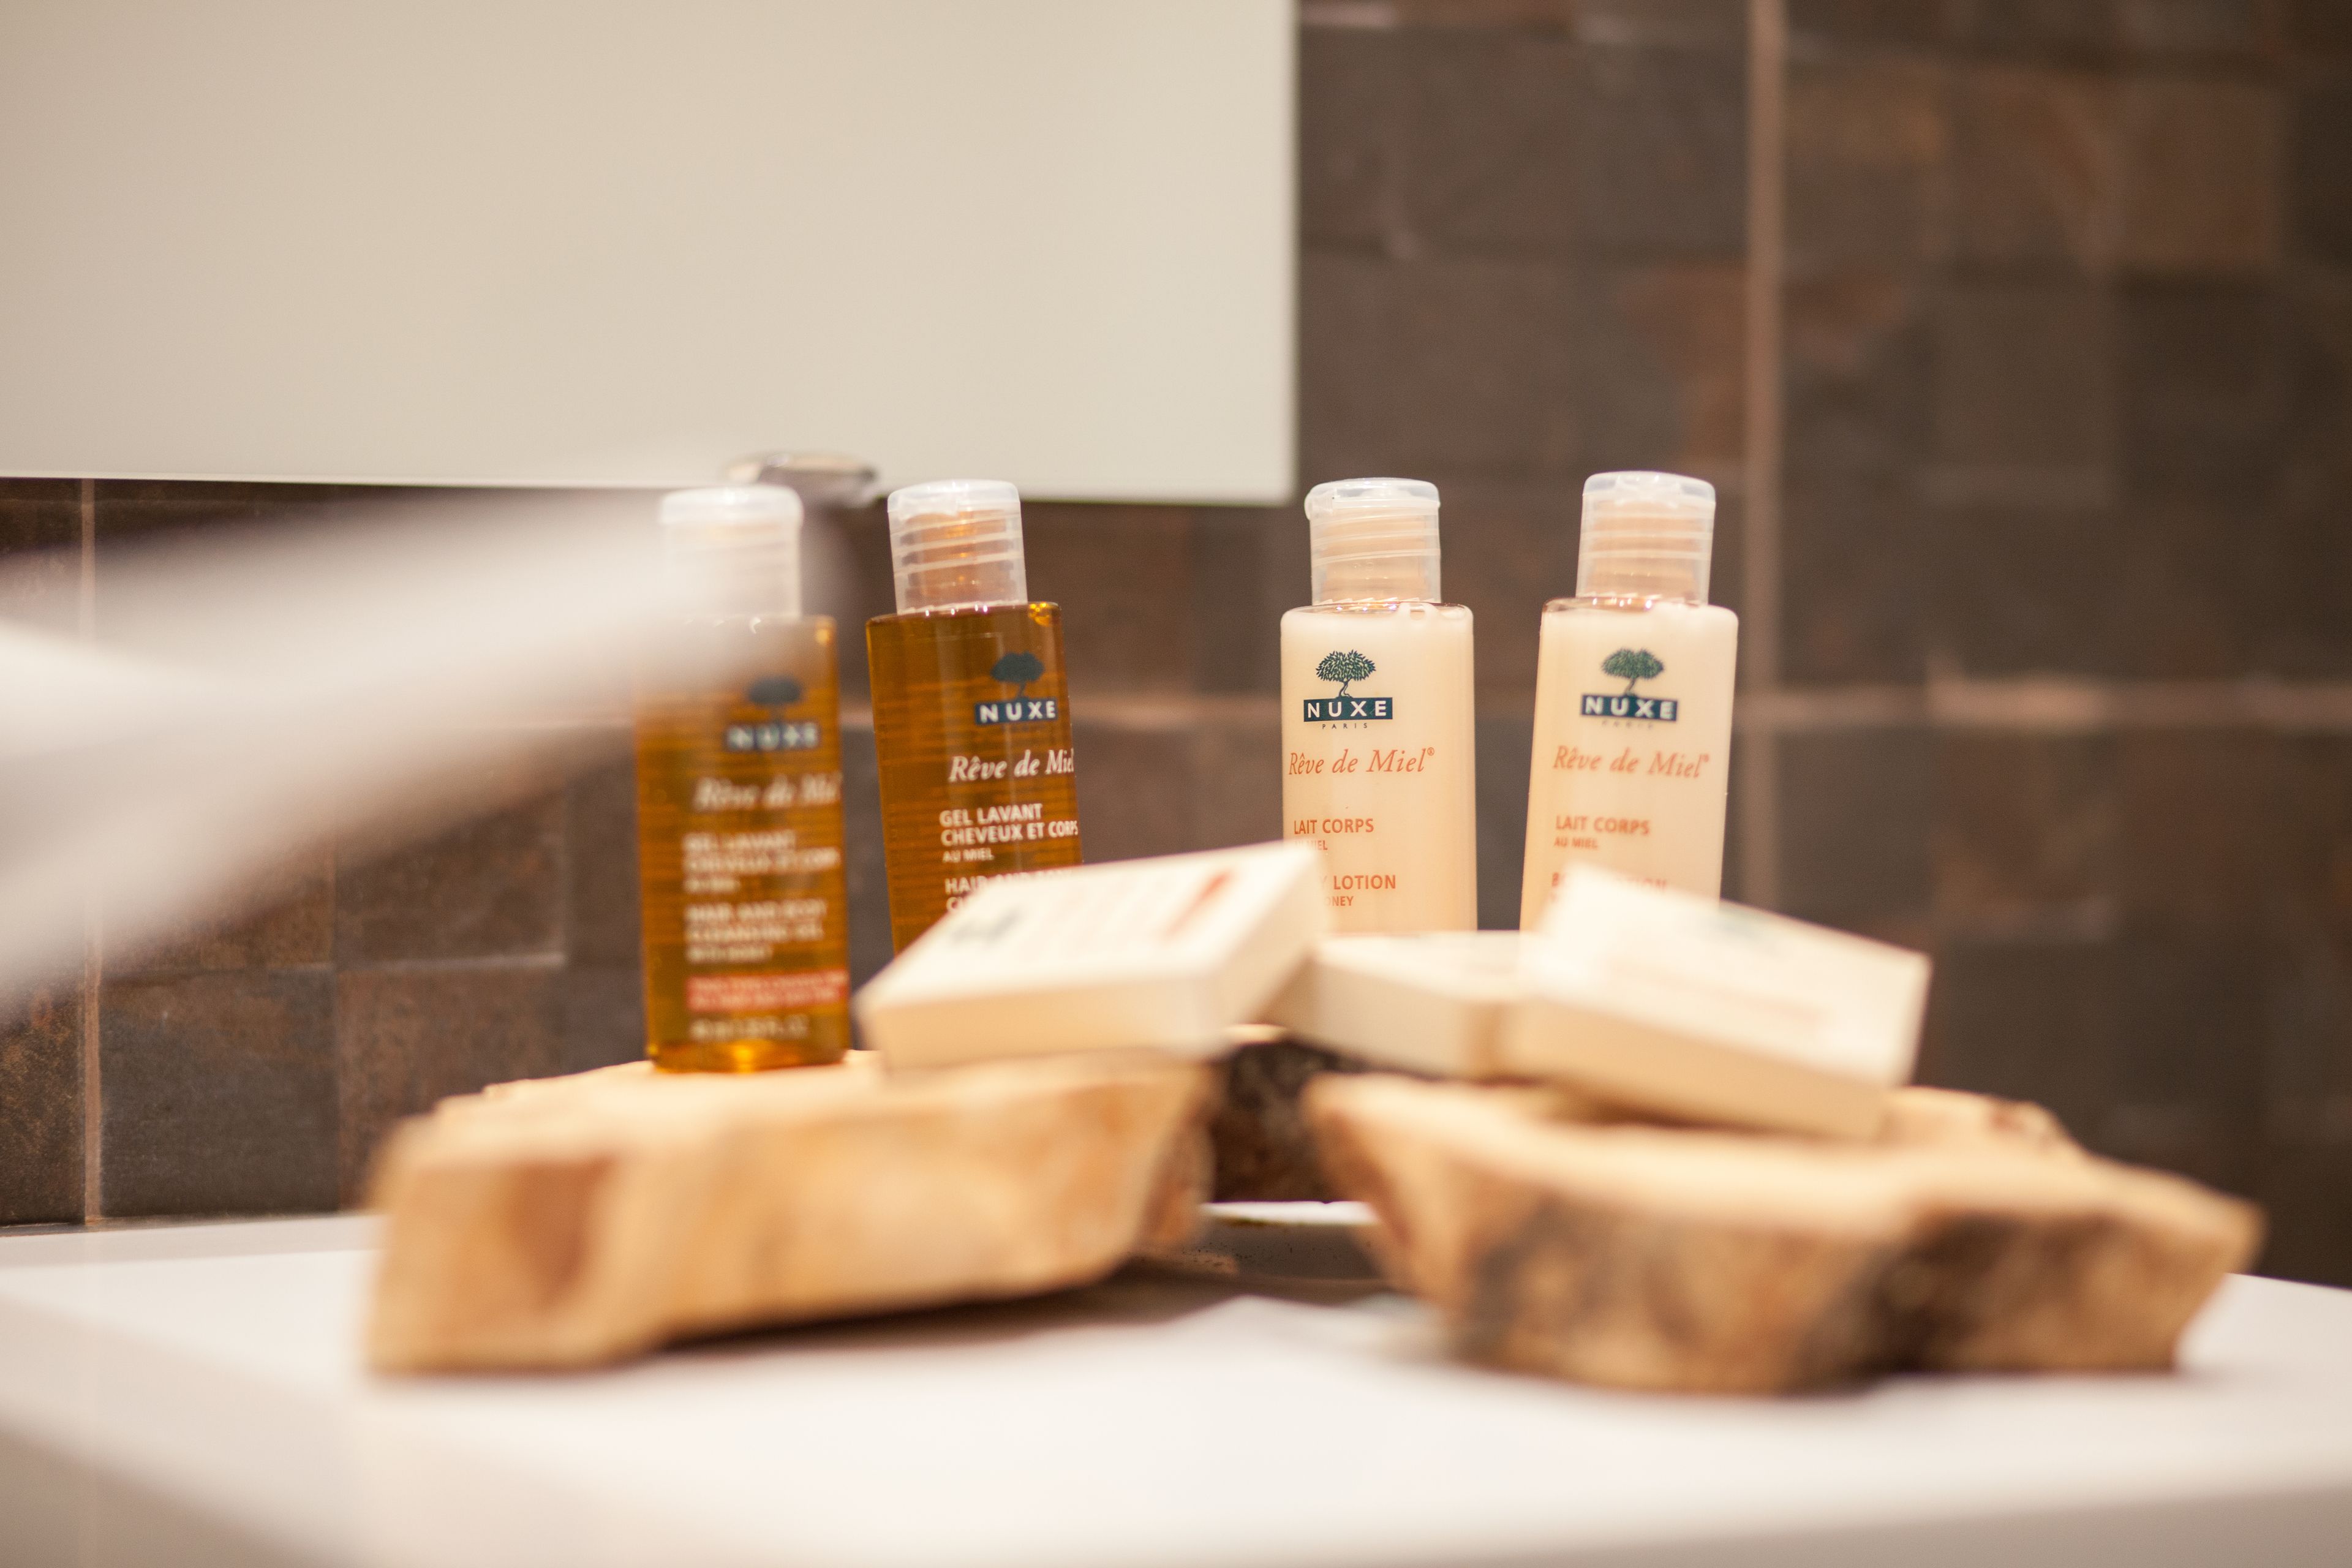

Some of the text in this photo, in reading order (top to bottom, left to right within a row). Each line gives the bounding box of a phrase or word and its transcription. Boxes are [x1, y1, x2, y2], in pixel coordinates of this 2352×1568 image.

[979, 700, 1057, 723] NUXE
[1308, 700, 1387, 718] NUXE
[1585, 696, 1675, 719] NUXE
[948, 755, 1008, 782] Rêve
[1014, 749, 1040, 777] de
[1289, 752, 1324, 775] Rêve
[1332, 748, 1358, 773] de
[1553, 745, 1602, 771] Rêve
[1609, 746, 1639, 773] de
[940, 803, 1042, 827] GEL LAVANT
[1294, 818, 1374, 834] LAIT CORPS
[1556, 815, 1651, 837] LAIT CORPS
[941, 820, 1079, 847] CHEVEUX ET CORPS
[1554, 837, 1599, 850] AU MIEL
[943, 848, 994, 864] AU MIEL
[1333, 874, 1396, 890] LOTION
